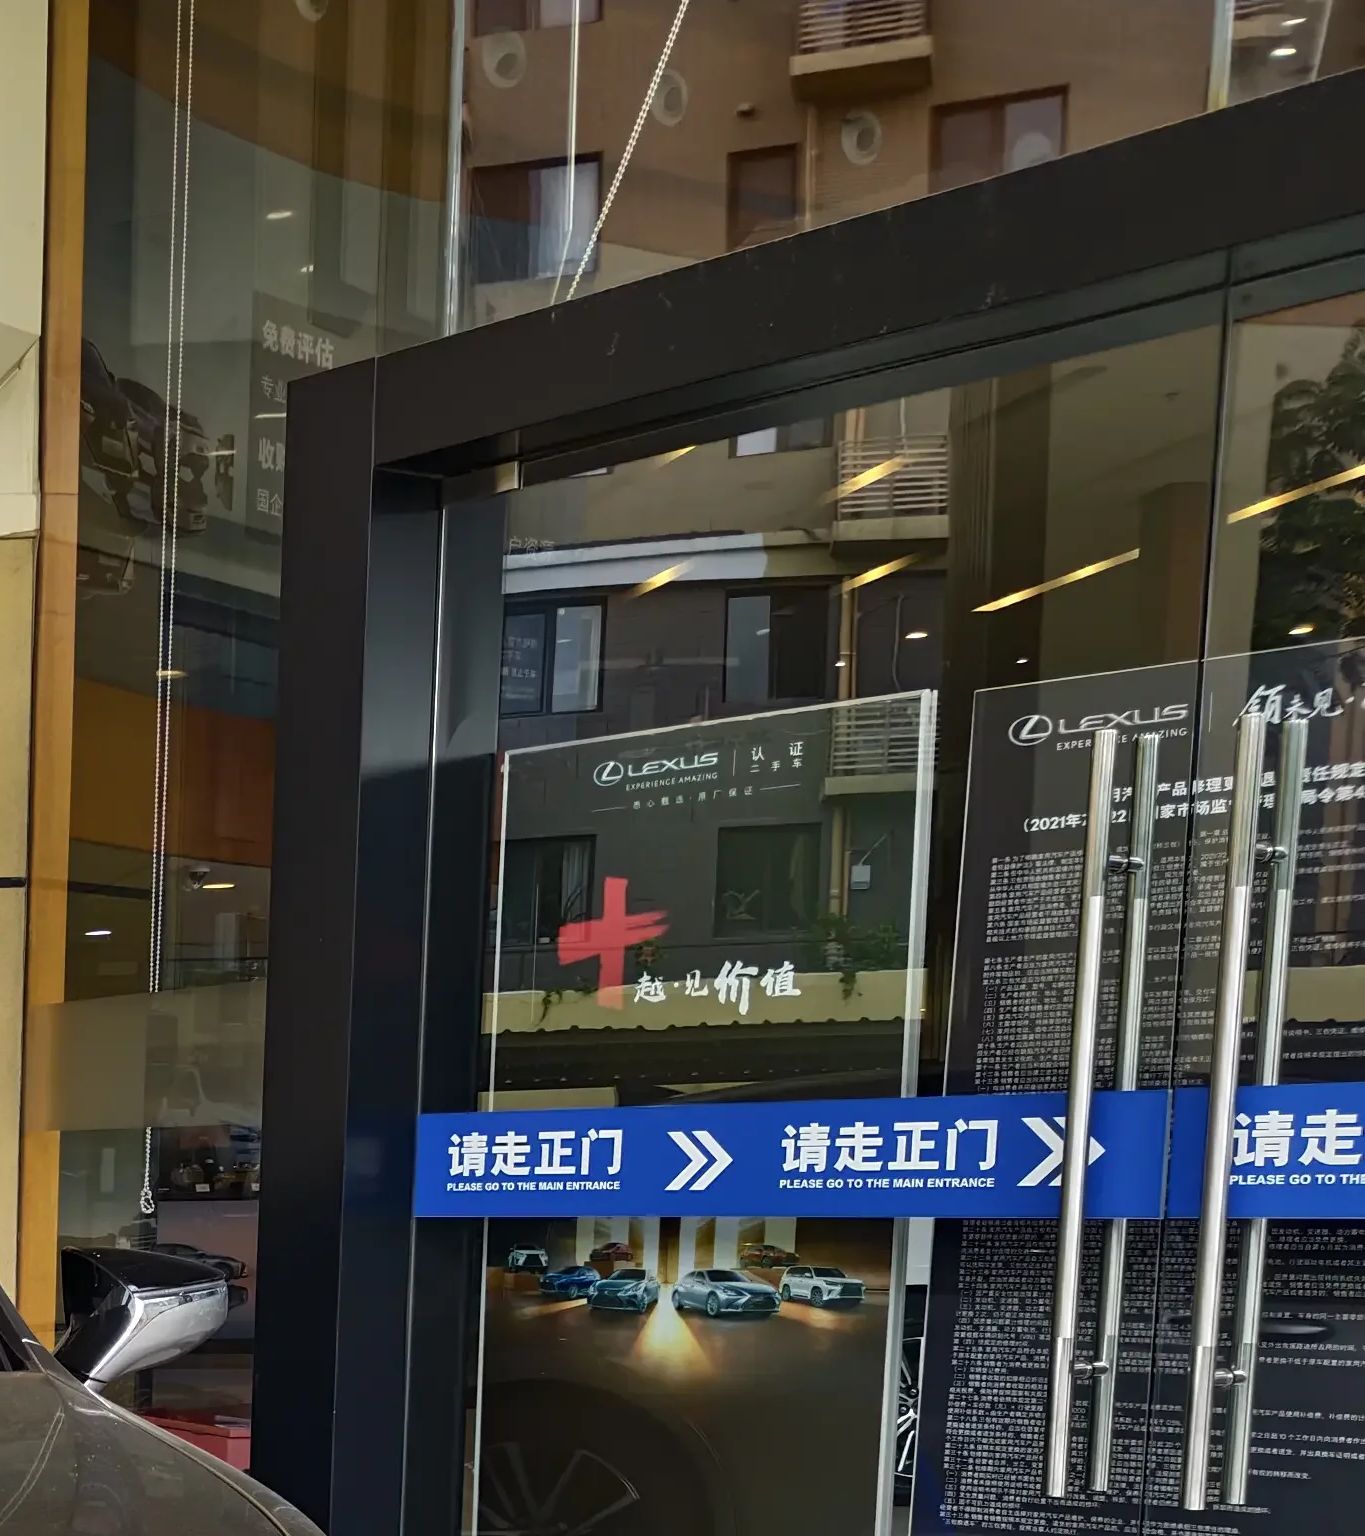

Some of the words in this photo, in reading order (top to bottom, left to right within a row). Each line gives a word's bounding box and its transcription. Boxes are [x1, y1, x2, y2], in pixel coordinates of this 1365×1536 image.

[1058, 703, 1189, 734] LEXUS
[750, 741, 805, 762] 认证
[627, 752, 719, 777] LEXUS
[625, 776, 676, 792] EXPERIENCE
[678, 771, 719, 785] AMAZING
[780, 1118, 999, 1174] 请走正门
[1233, 1108, 1363, 1168] 请走
[447, 1127, 624, 1178] 请走正门
[446, 1182, 483, 1193] PLEASE
[484, 1182, 500, 1192] GO
[500, 1182, 515, 1192] TO
[518, 1181, 537, 1191] THE
[538, 1181, 564, 1191] MAIN
[565, 1180, 621, 1191] ENTRANCE
[779, 1178, 824, 1189] PLEASE
[825, 1178, 844, 1189] GO
[846, 1178, 863, 1189] TO
[866, 1178, 890, 1189] THE
[892, 1177, 924, 1188] MAIN
[927, 1177, 995, 1189] ENTRANCE
[1229, 1173, 1286, 1186] PLEASE
[1288, 1173, 1311, 1185] GO
[1315, 1173, 1336, 1185] TO
